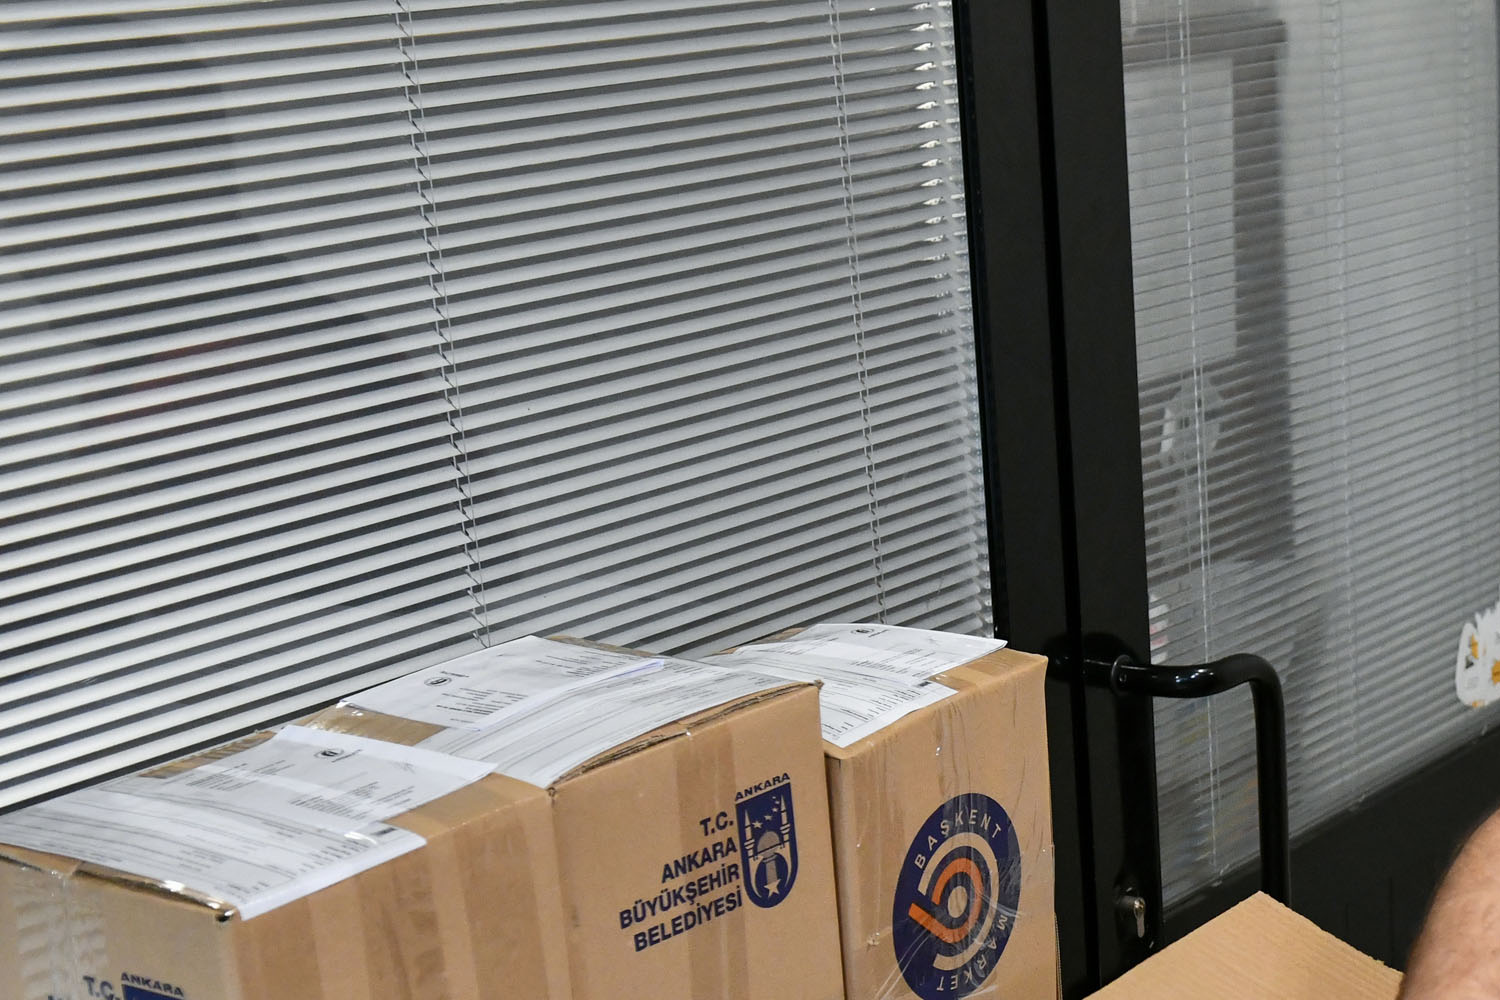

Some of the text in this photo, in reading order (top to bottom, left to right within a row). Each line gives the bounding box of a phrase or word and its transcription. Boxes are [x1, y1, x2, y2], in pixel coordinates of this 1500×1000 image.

[735, 772, 791, 801] ANKARA
[699, 811, 734, 837] T.C.
[914, 809, 1002, 870] BAŞKENT
[661, 837, 737, 884] ANKARA
[619, 862, 740, 930] BÜYÜKŞEHİR
[634, 885, 743, 952] BELEDİYESİ
[937, 915, 1008, 991] MARKET
[121, 972, 184, 997] ANKARA
